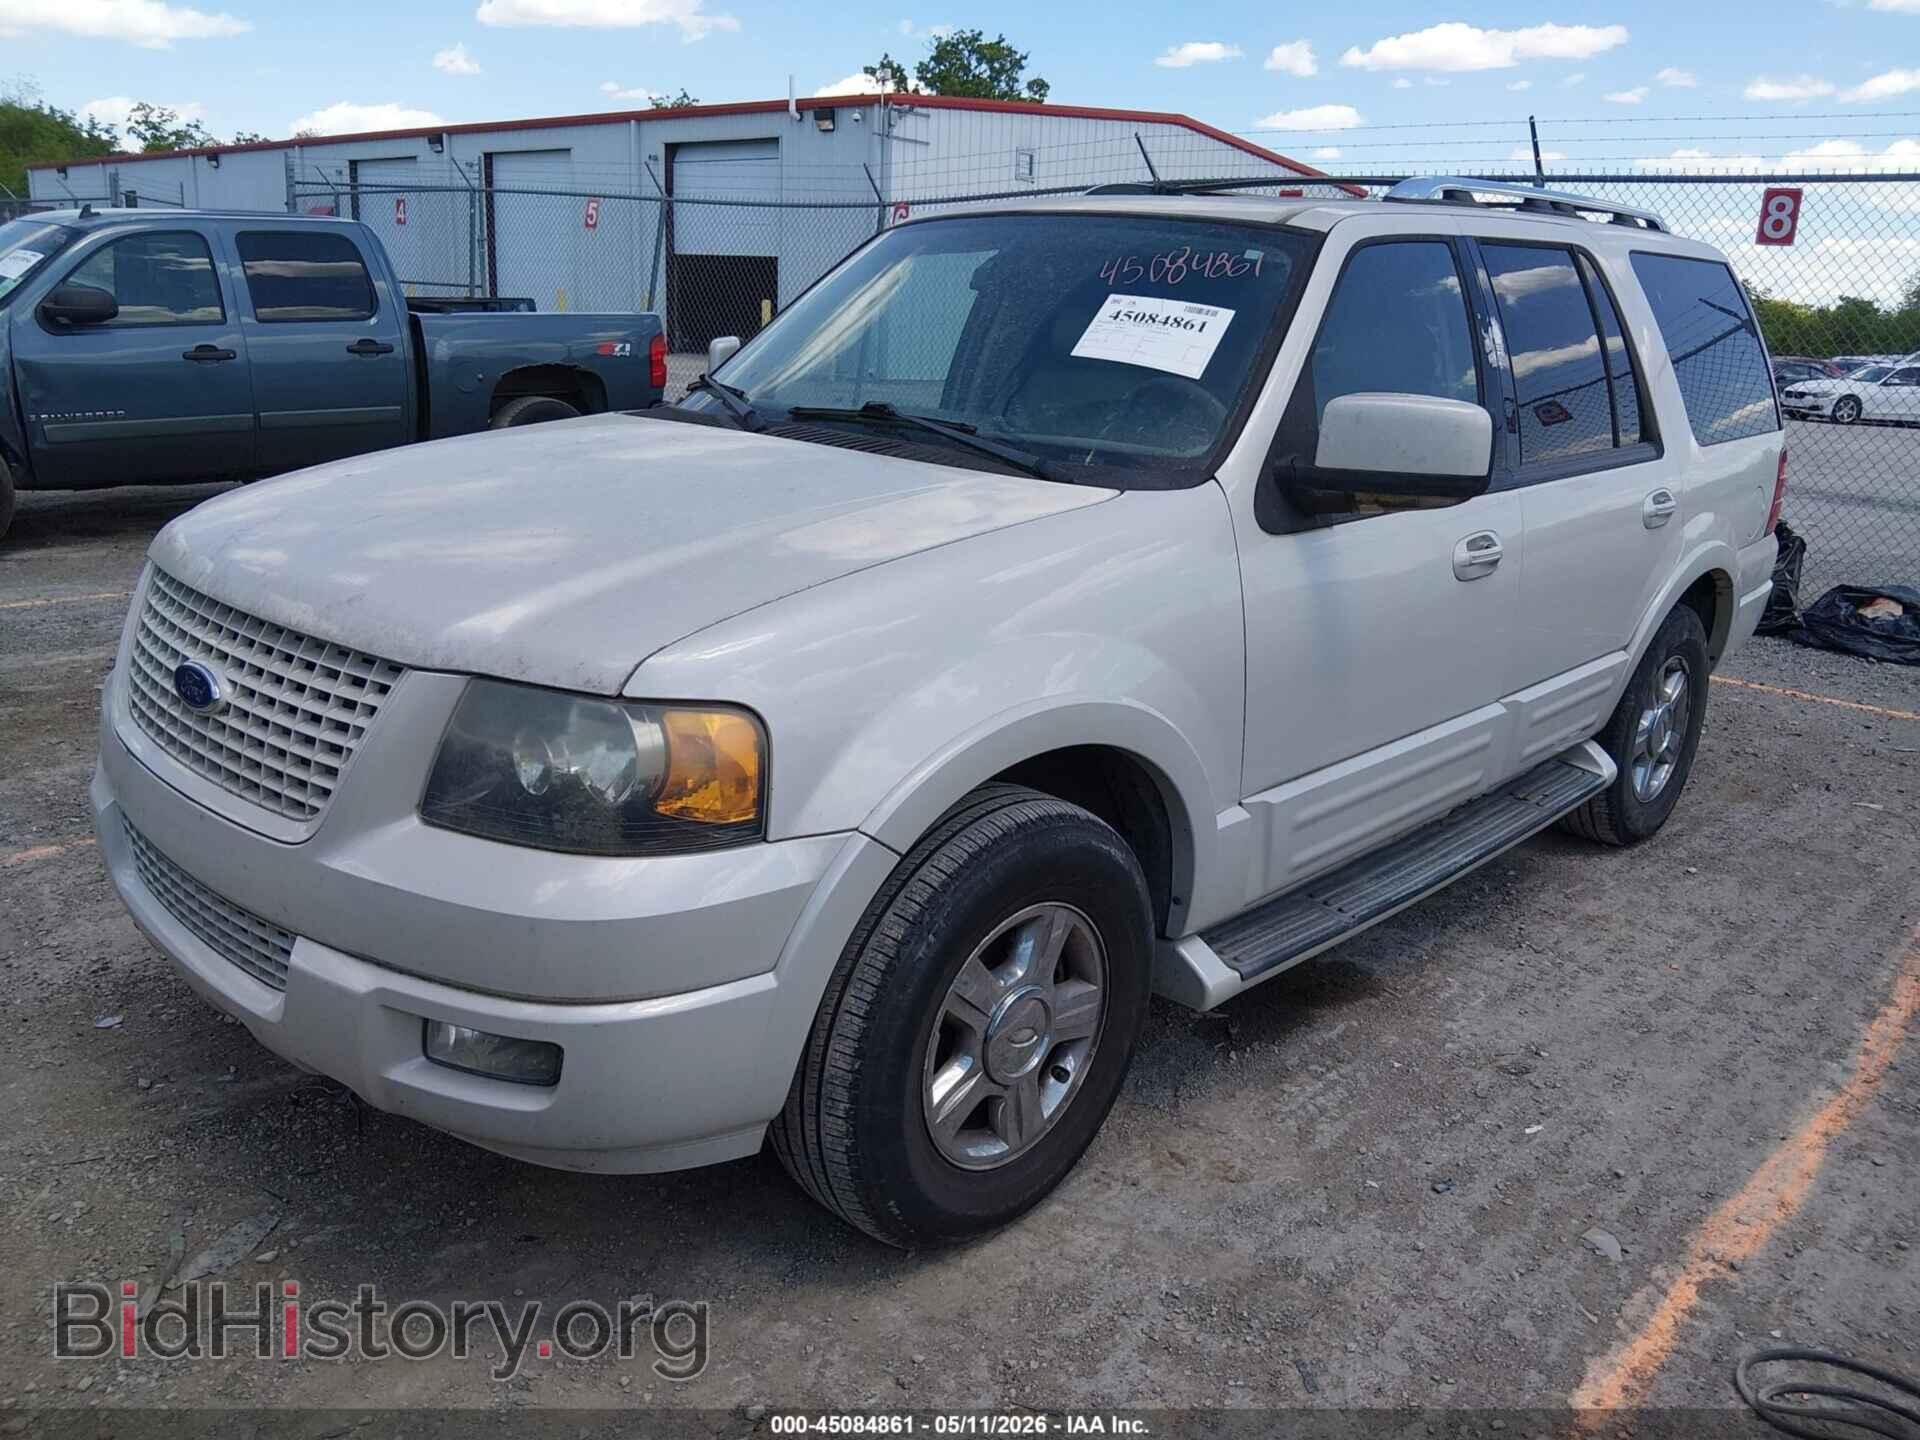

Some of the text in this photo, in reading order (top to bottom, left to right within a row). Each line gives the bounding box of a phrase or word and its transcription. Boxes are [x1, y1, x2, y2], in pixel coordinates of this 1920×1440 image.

[587, 202, 598, 225] 5
[1763, 195, 1794, 239] 8
[1109, 309, 1208, 333] 45084861
